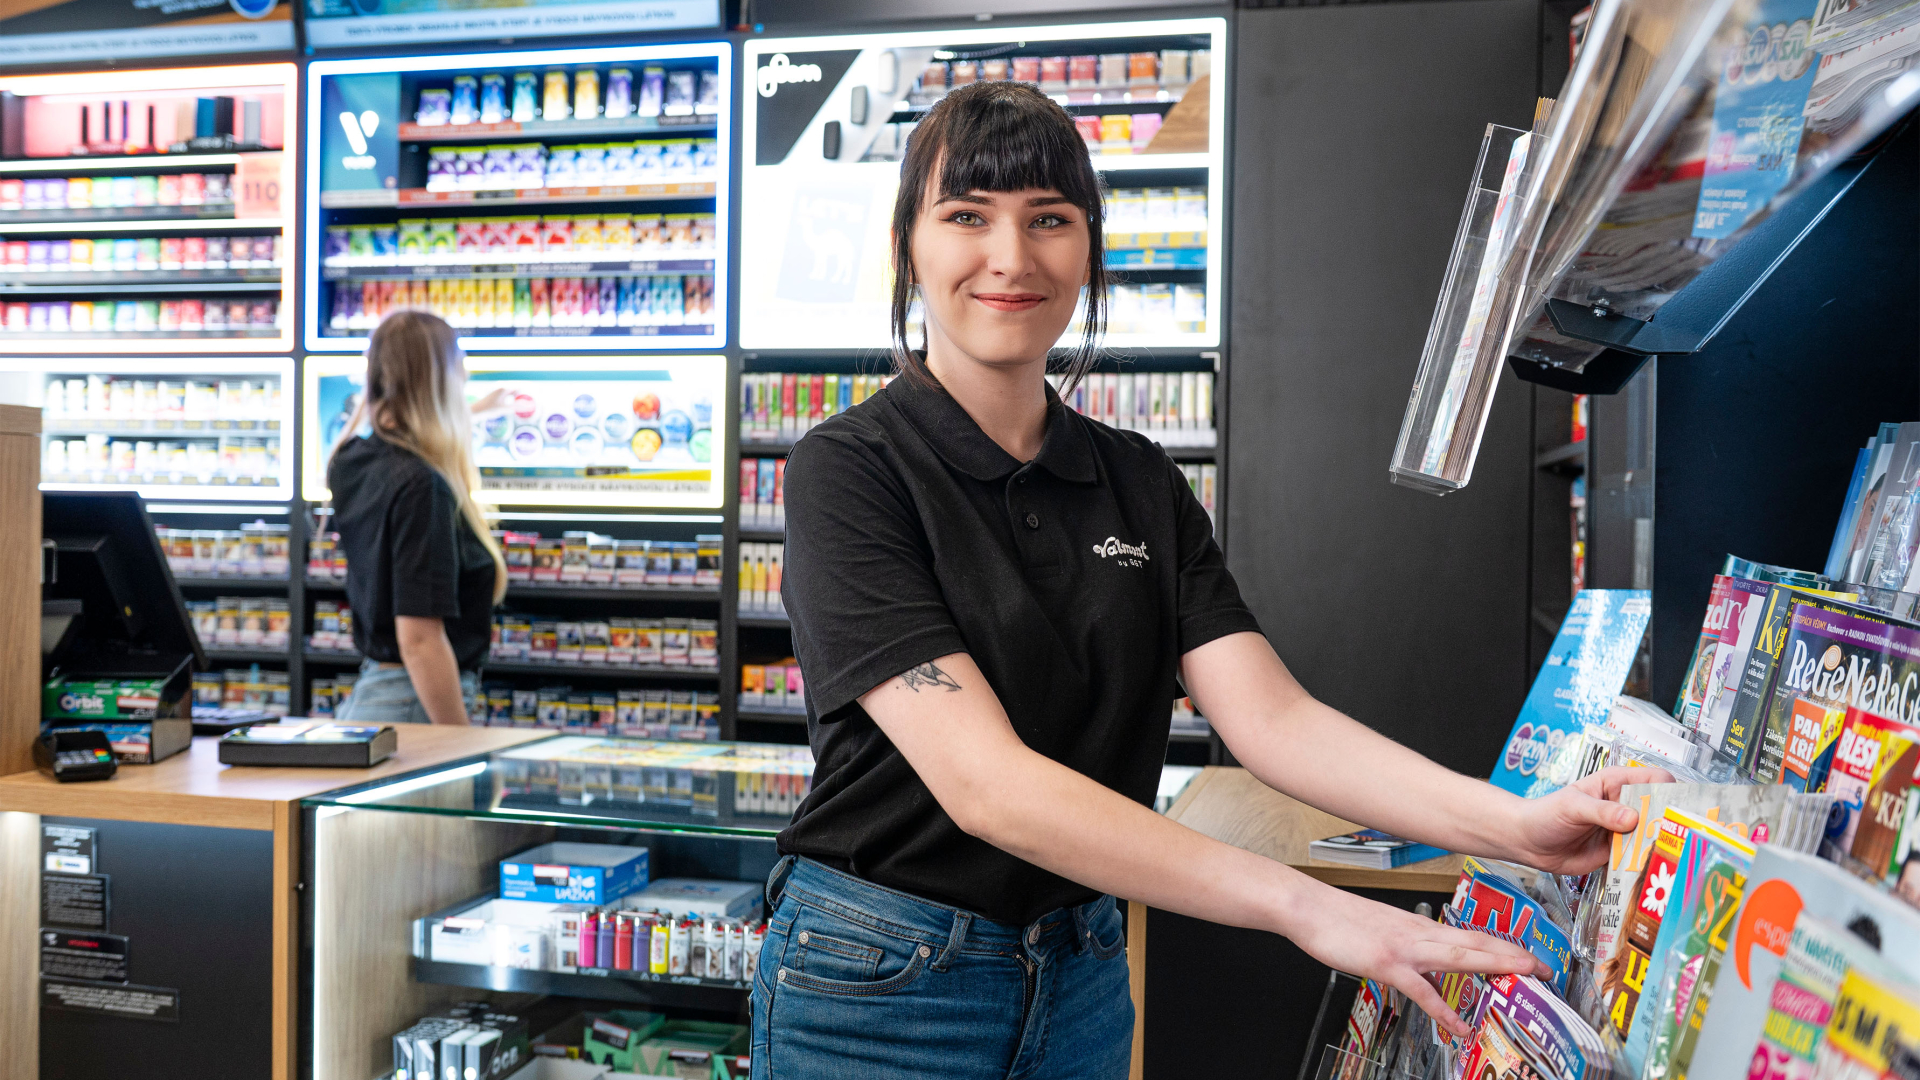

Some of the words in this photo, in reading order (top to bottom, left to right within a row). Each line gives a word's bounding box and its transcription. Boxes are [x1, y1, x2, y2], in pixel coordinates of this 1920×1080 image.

[59, 692, 106, 713] Orbit
[1731, 719, 1746, 738] Sex
[1469, 879, 1534, 939] TV
[1514, 992, 1523, 1004] 85
[1520, 997, 1536, 1019] stanic
